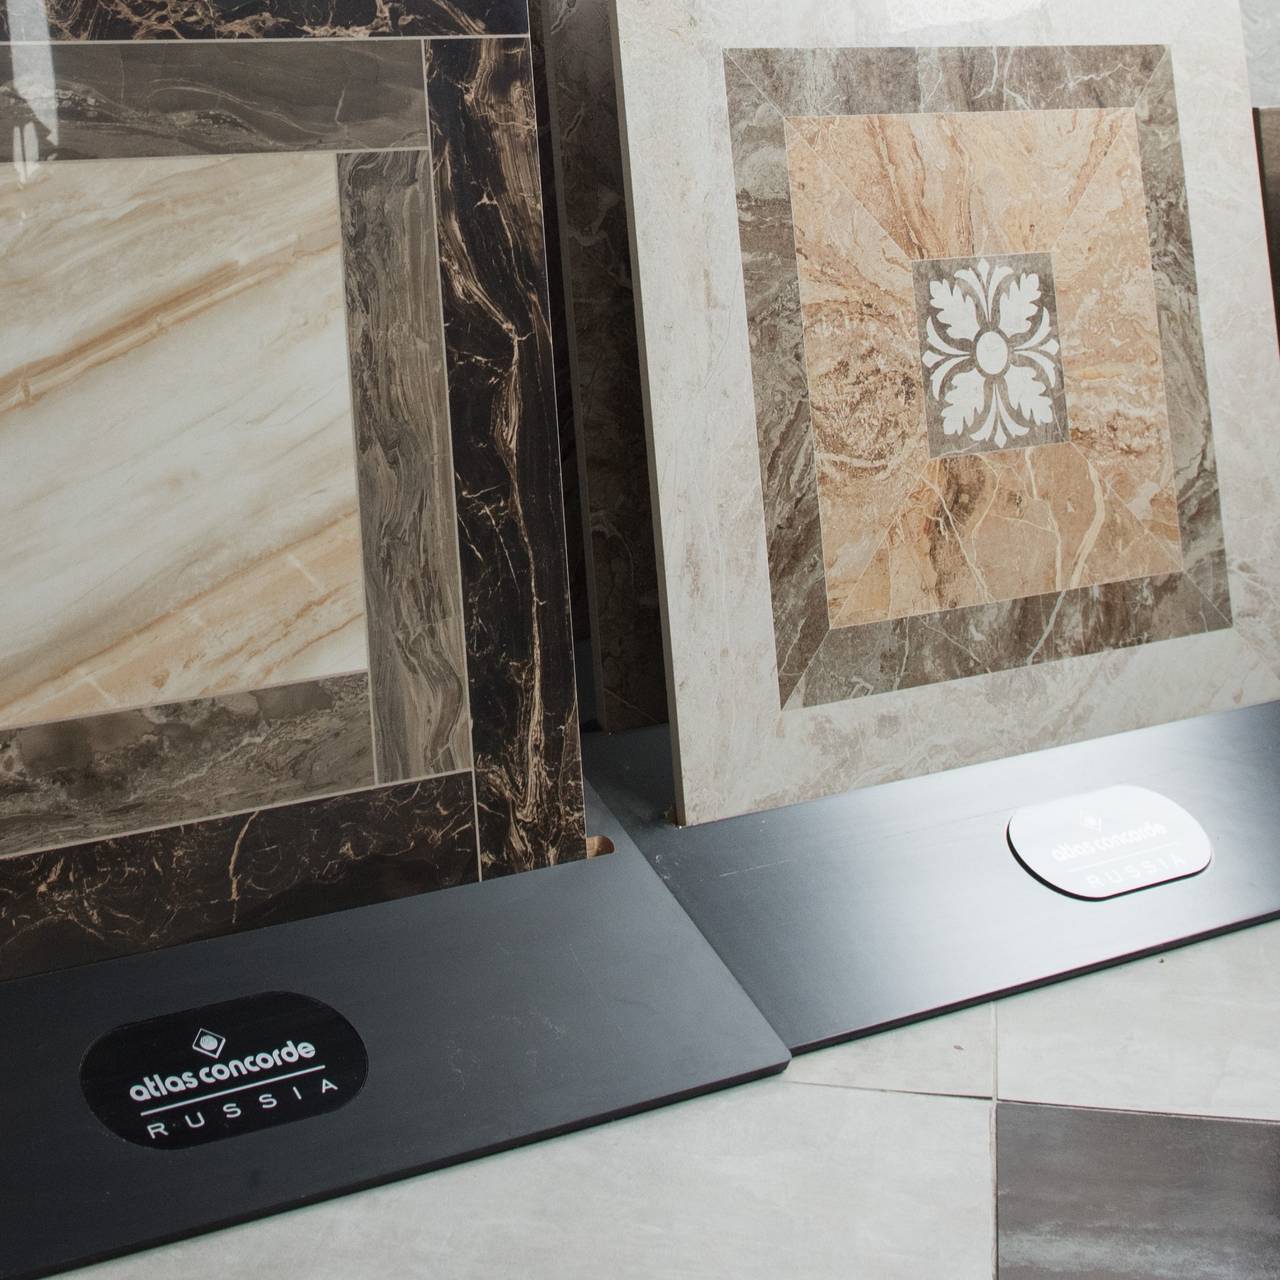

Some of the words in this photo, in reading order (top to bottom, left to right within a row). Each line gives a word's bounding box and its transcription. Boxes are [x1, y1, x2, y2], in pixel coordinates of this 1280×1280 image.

[1084, 852, 1187, 889] RUSSIA
[129, 1071, 199, 1101] atlas
[198, 1040, 317, 1084] concorde
[147, 1078, 339, 1139] RUSSIA
